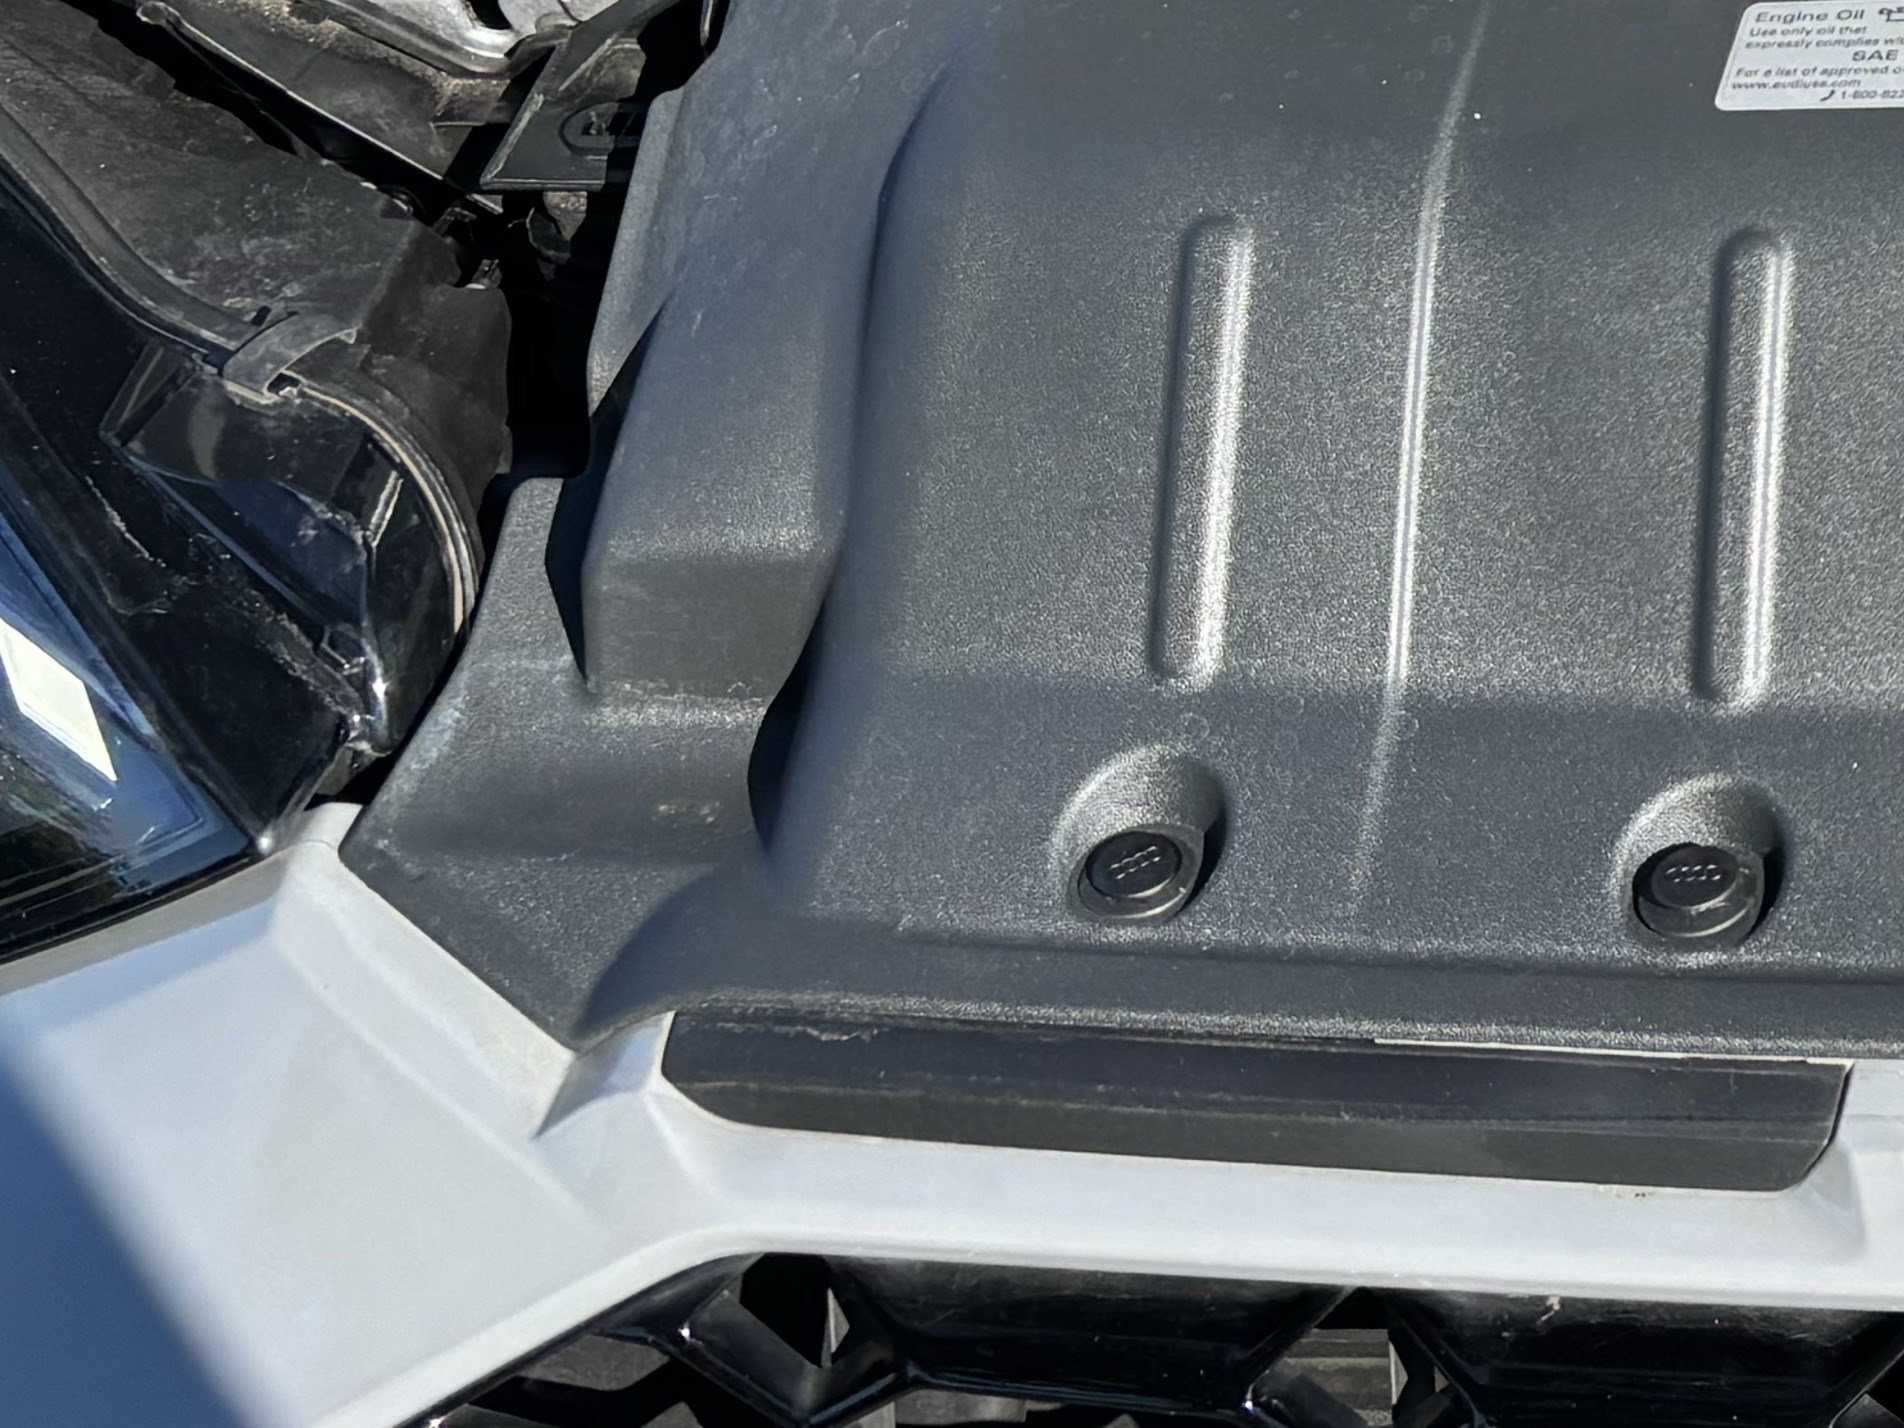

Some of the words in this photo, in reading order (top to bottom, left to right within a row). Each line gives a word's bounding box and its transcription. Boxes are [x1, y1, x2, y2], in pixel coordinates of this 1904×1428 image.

[1755, 11, 1829, 25] Engine
[1837, 9, 1866, 21] Oil
[1851, 49, 1899, 61] SAE
